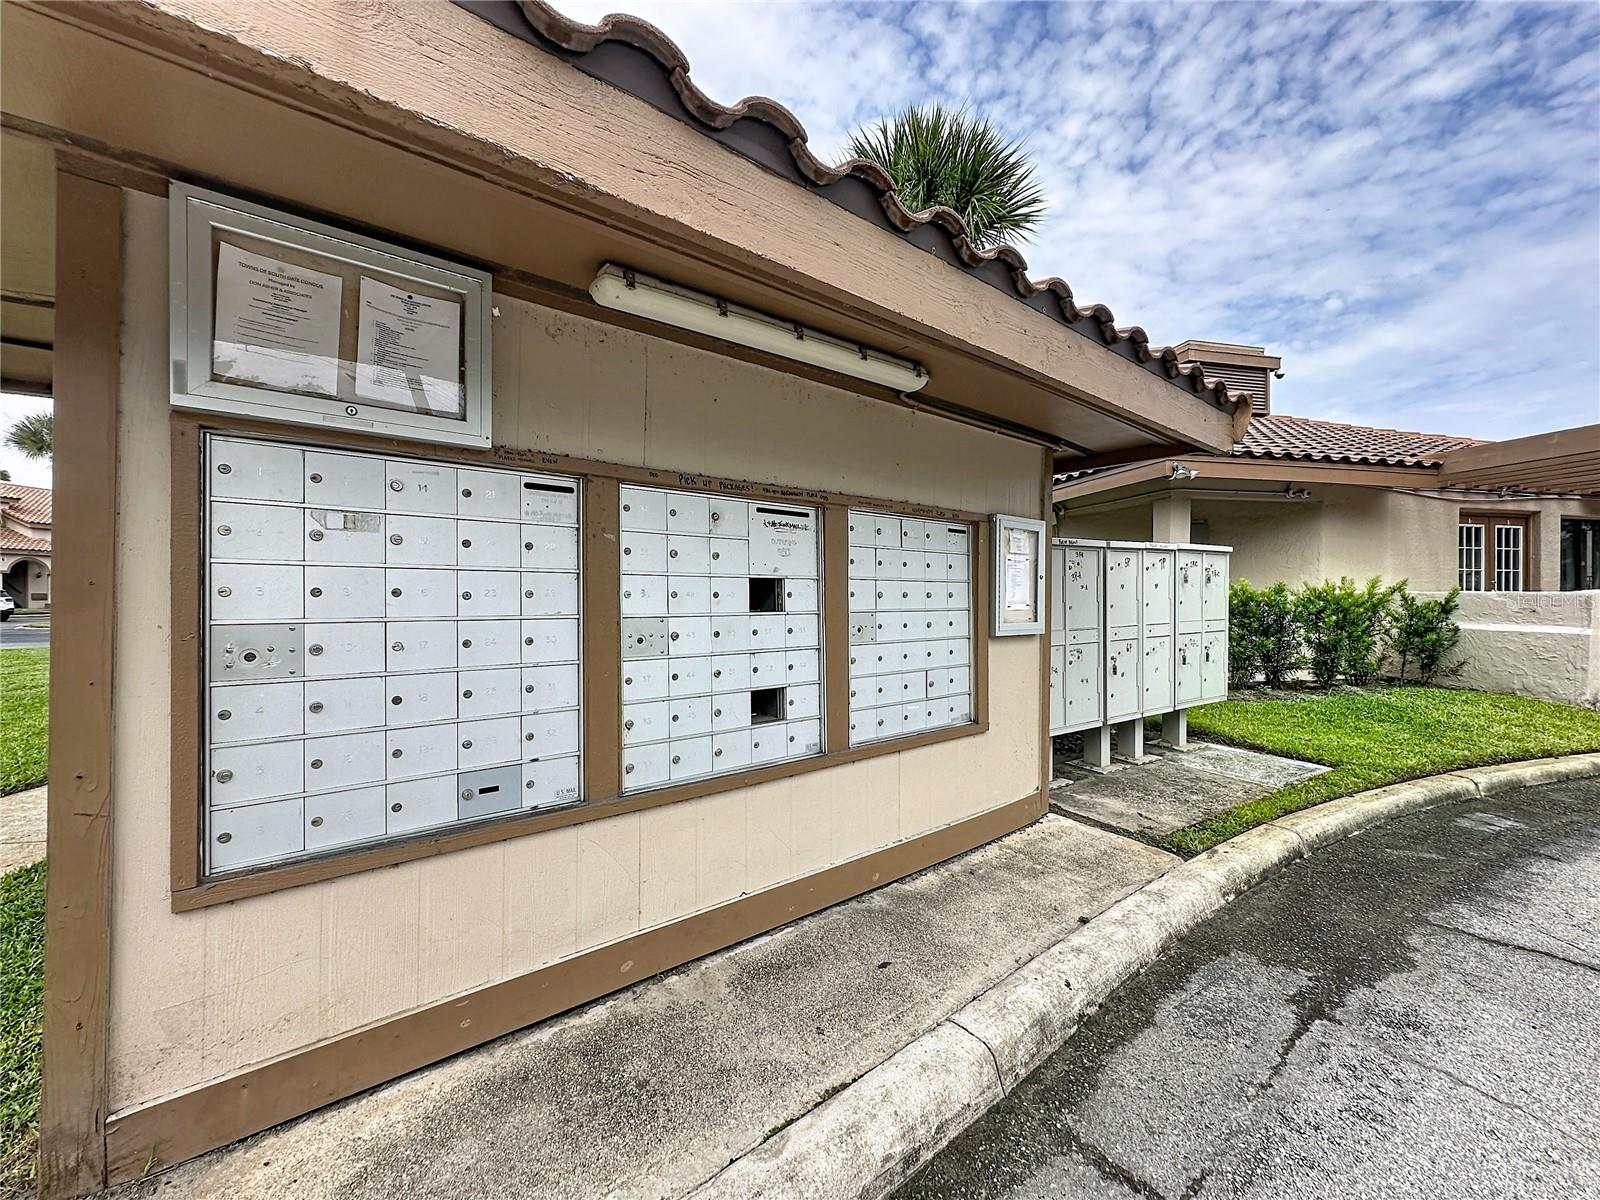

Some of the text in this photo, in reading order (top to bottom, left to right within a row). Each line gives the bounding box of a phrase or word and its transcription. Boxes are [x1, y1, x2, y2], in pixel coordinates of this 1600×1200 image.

[239, 261, 259, 272] TOWNS
[678, 473, 697, 486] PICK
[702, 481, 712, 489] UP
